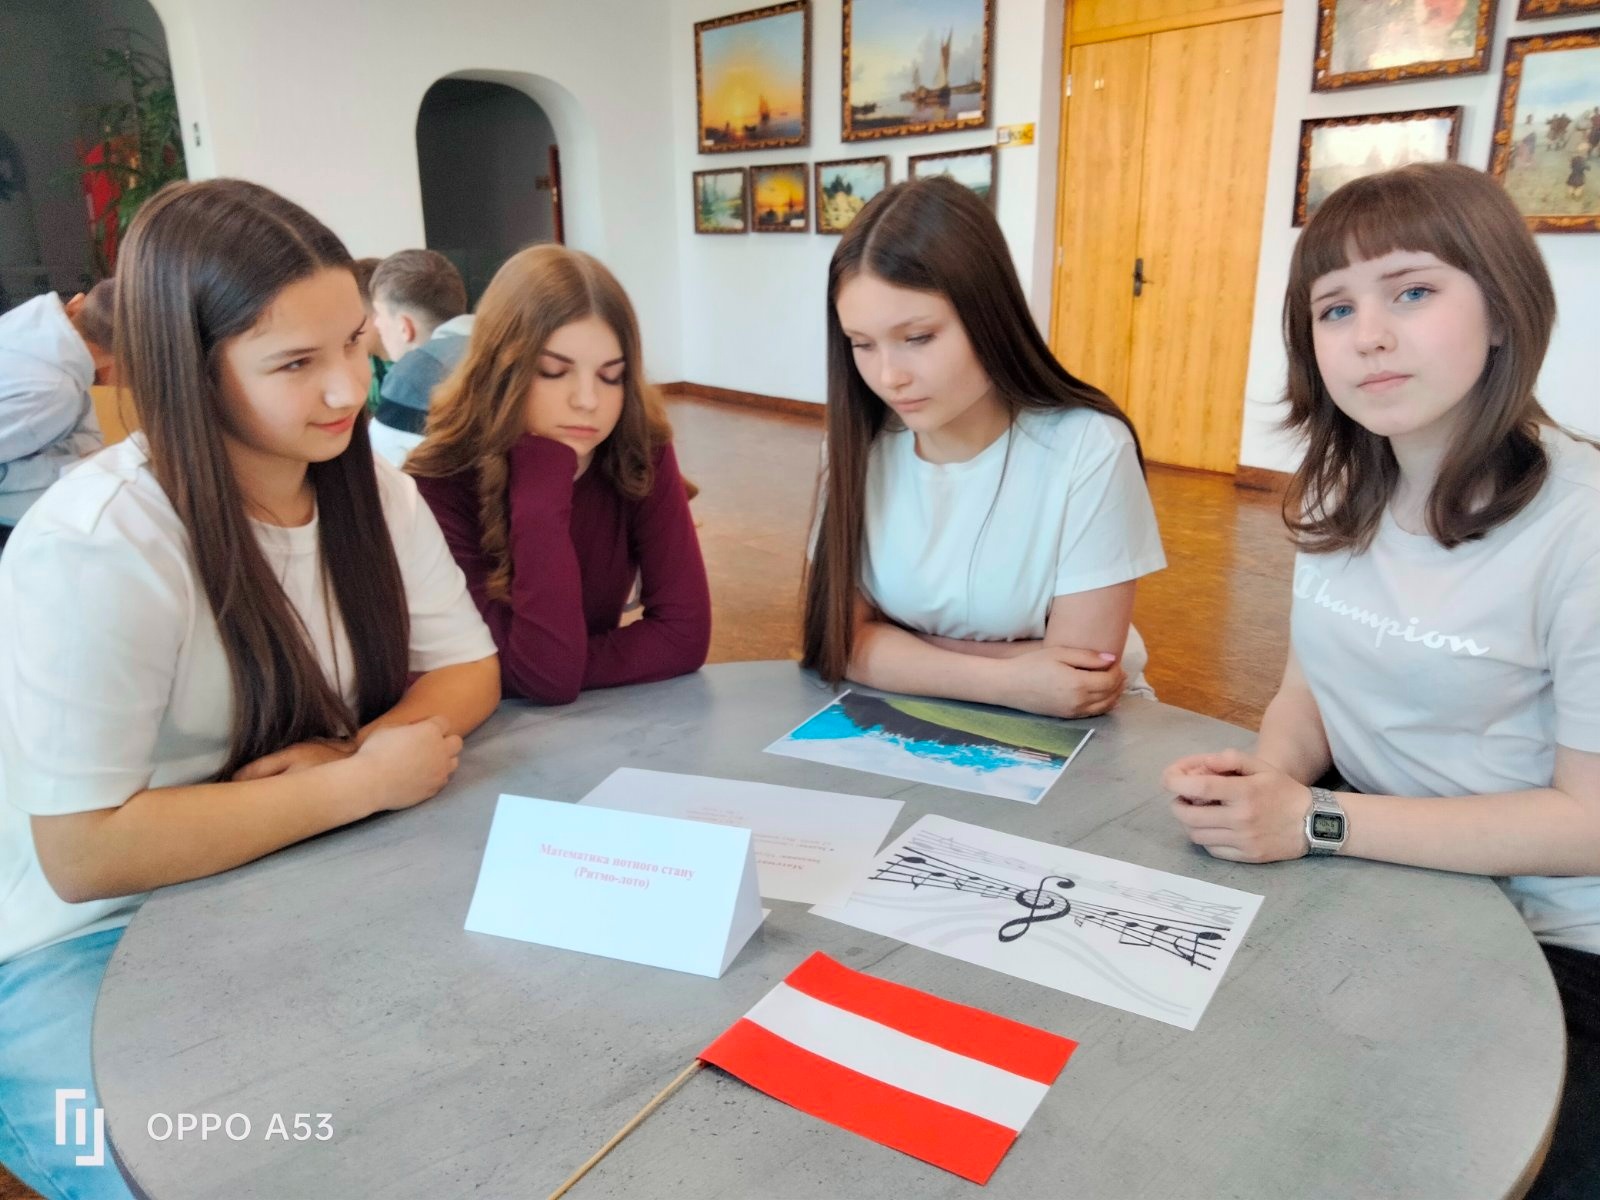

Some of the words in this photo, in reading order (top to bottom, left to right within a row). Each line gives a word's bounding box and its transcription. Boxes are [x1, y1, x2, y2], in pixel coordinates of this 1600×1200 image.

[1293, 564, 1490, 656] Champion
[540, 842, 609, 866] Математика
[611, 857, 659, 873] нотного
[661, 865, 695, 882] стану
[573, 865, 650, 890] (Ритмо-лото)
